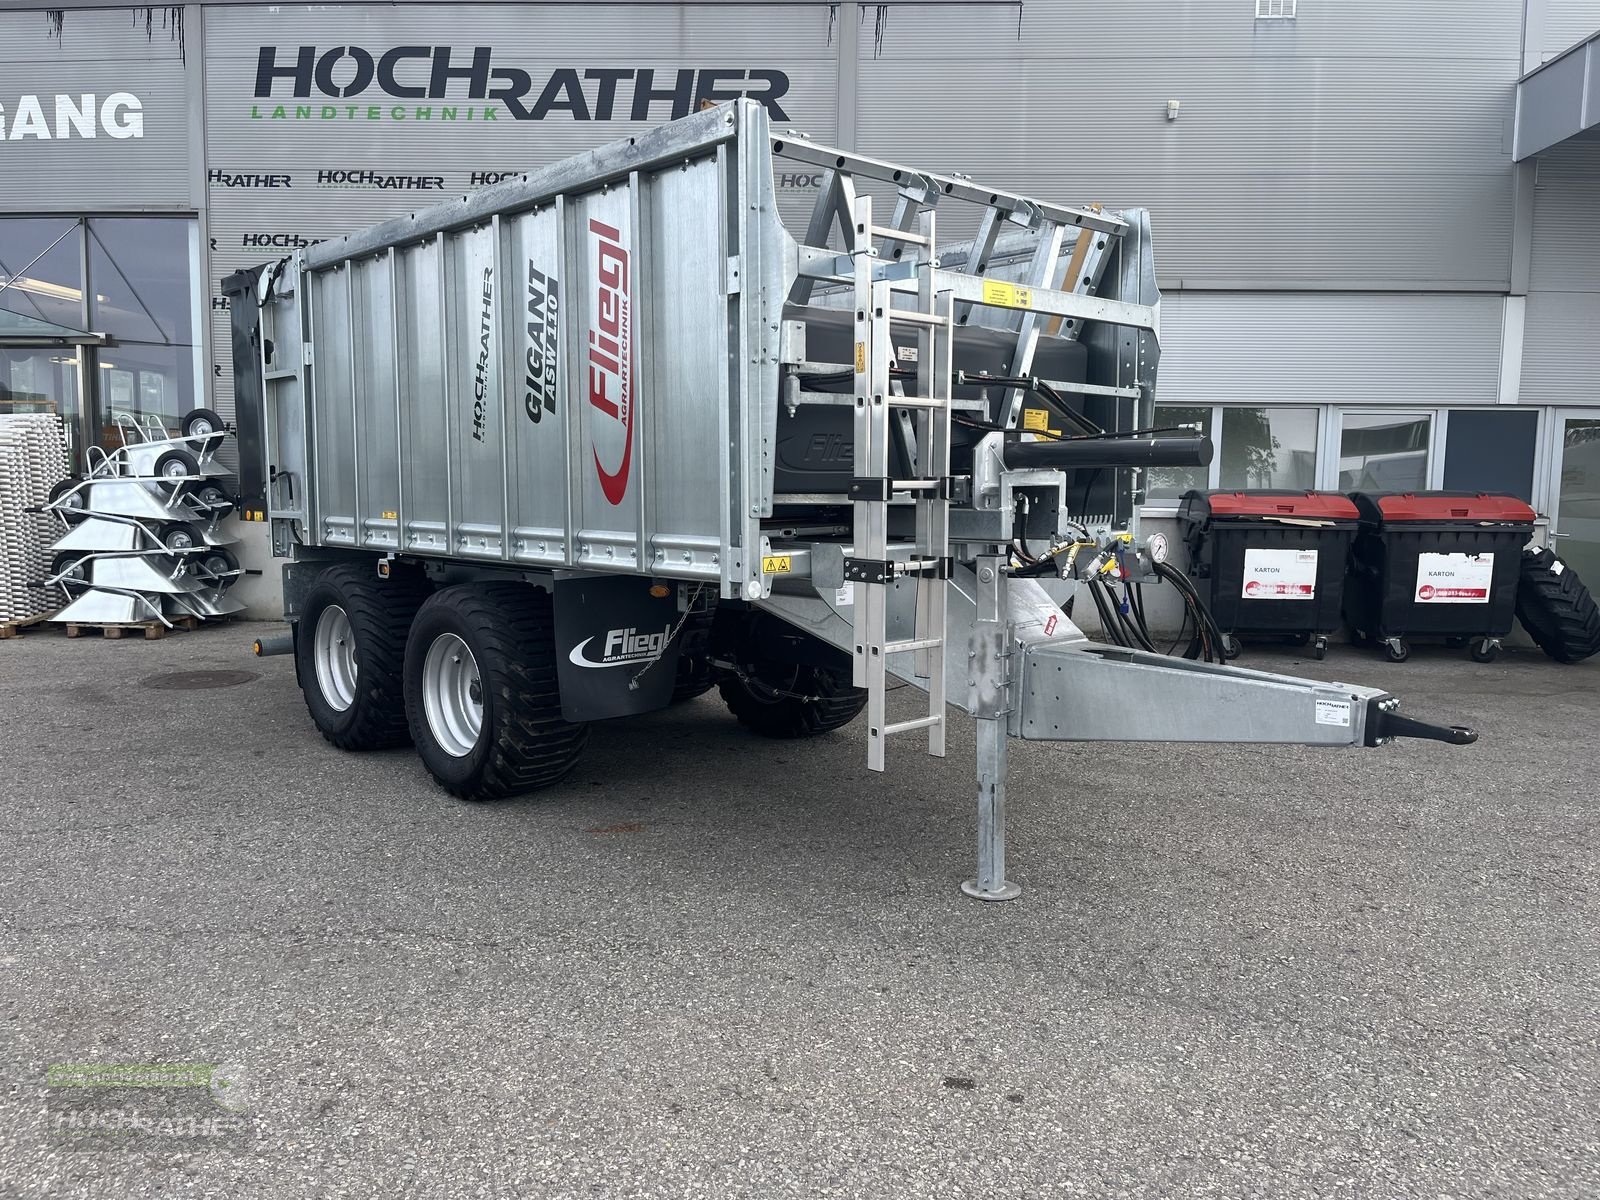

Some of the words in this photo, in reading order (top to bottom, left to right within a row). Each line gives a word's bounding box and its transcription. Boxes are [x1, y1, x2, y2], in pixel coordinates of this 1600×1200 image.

[254, 46, 791, 121] HOCHRATHER
[0, 92, 144, 141] ANG
[251, 105, 499, 121] LANDTECHNIK
[317, 170, 444, 189] HOCHRATHER
[525, 259, 546, 424] GIGANT
[547, 294, 558, 341] 110
[589, 218, 628, 420] Fliegl
[473, 266, 493, 442] HOCHRATHER
[545, 343, 556, 401] ASW
[603, 652, 647, 662] AGRARTECHNIK
[604, 624, 671, 656] Fliegl
